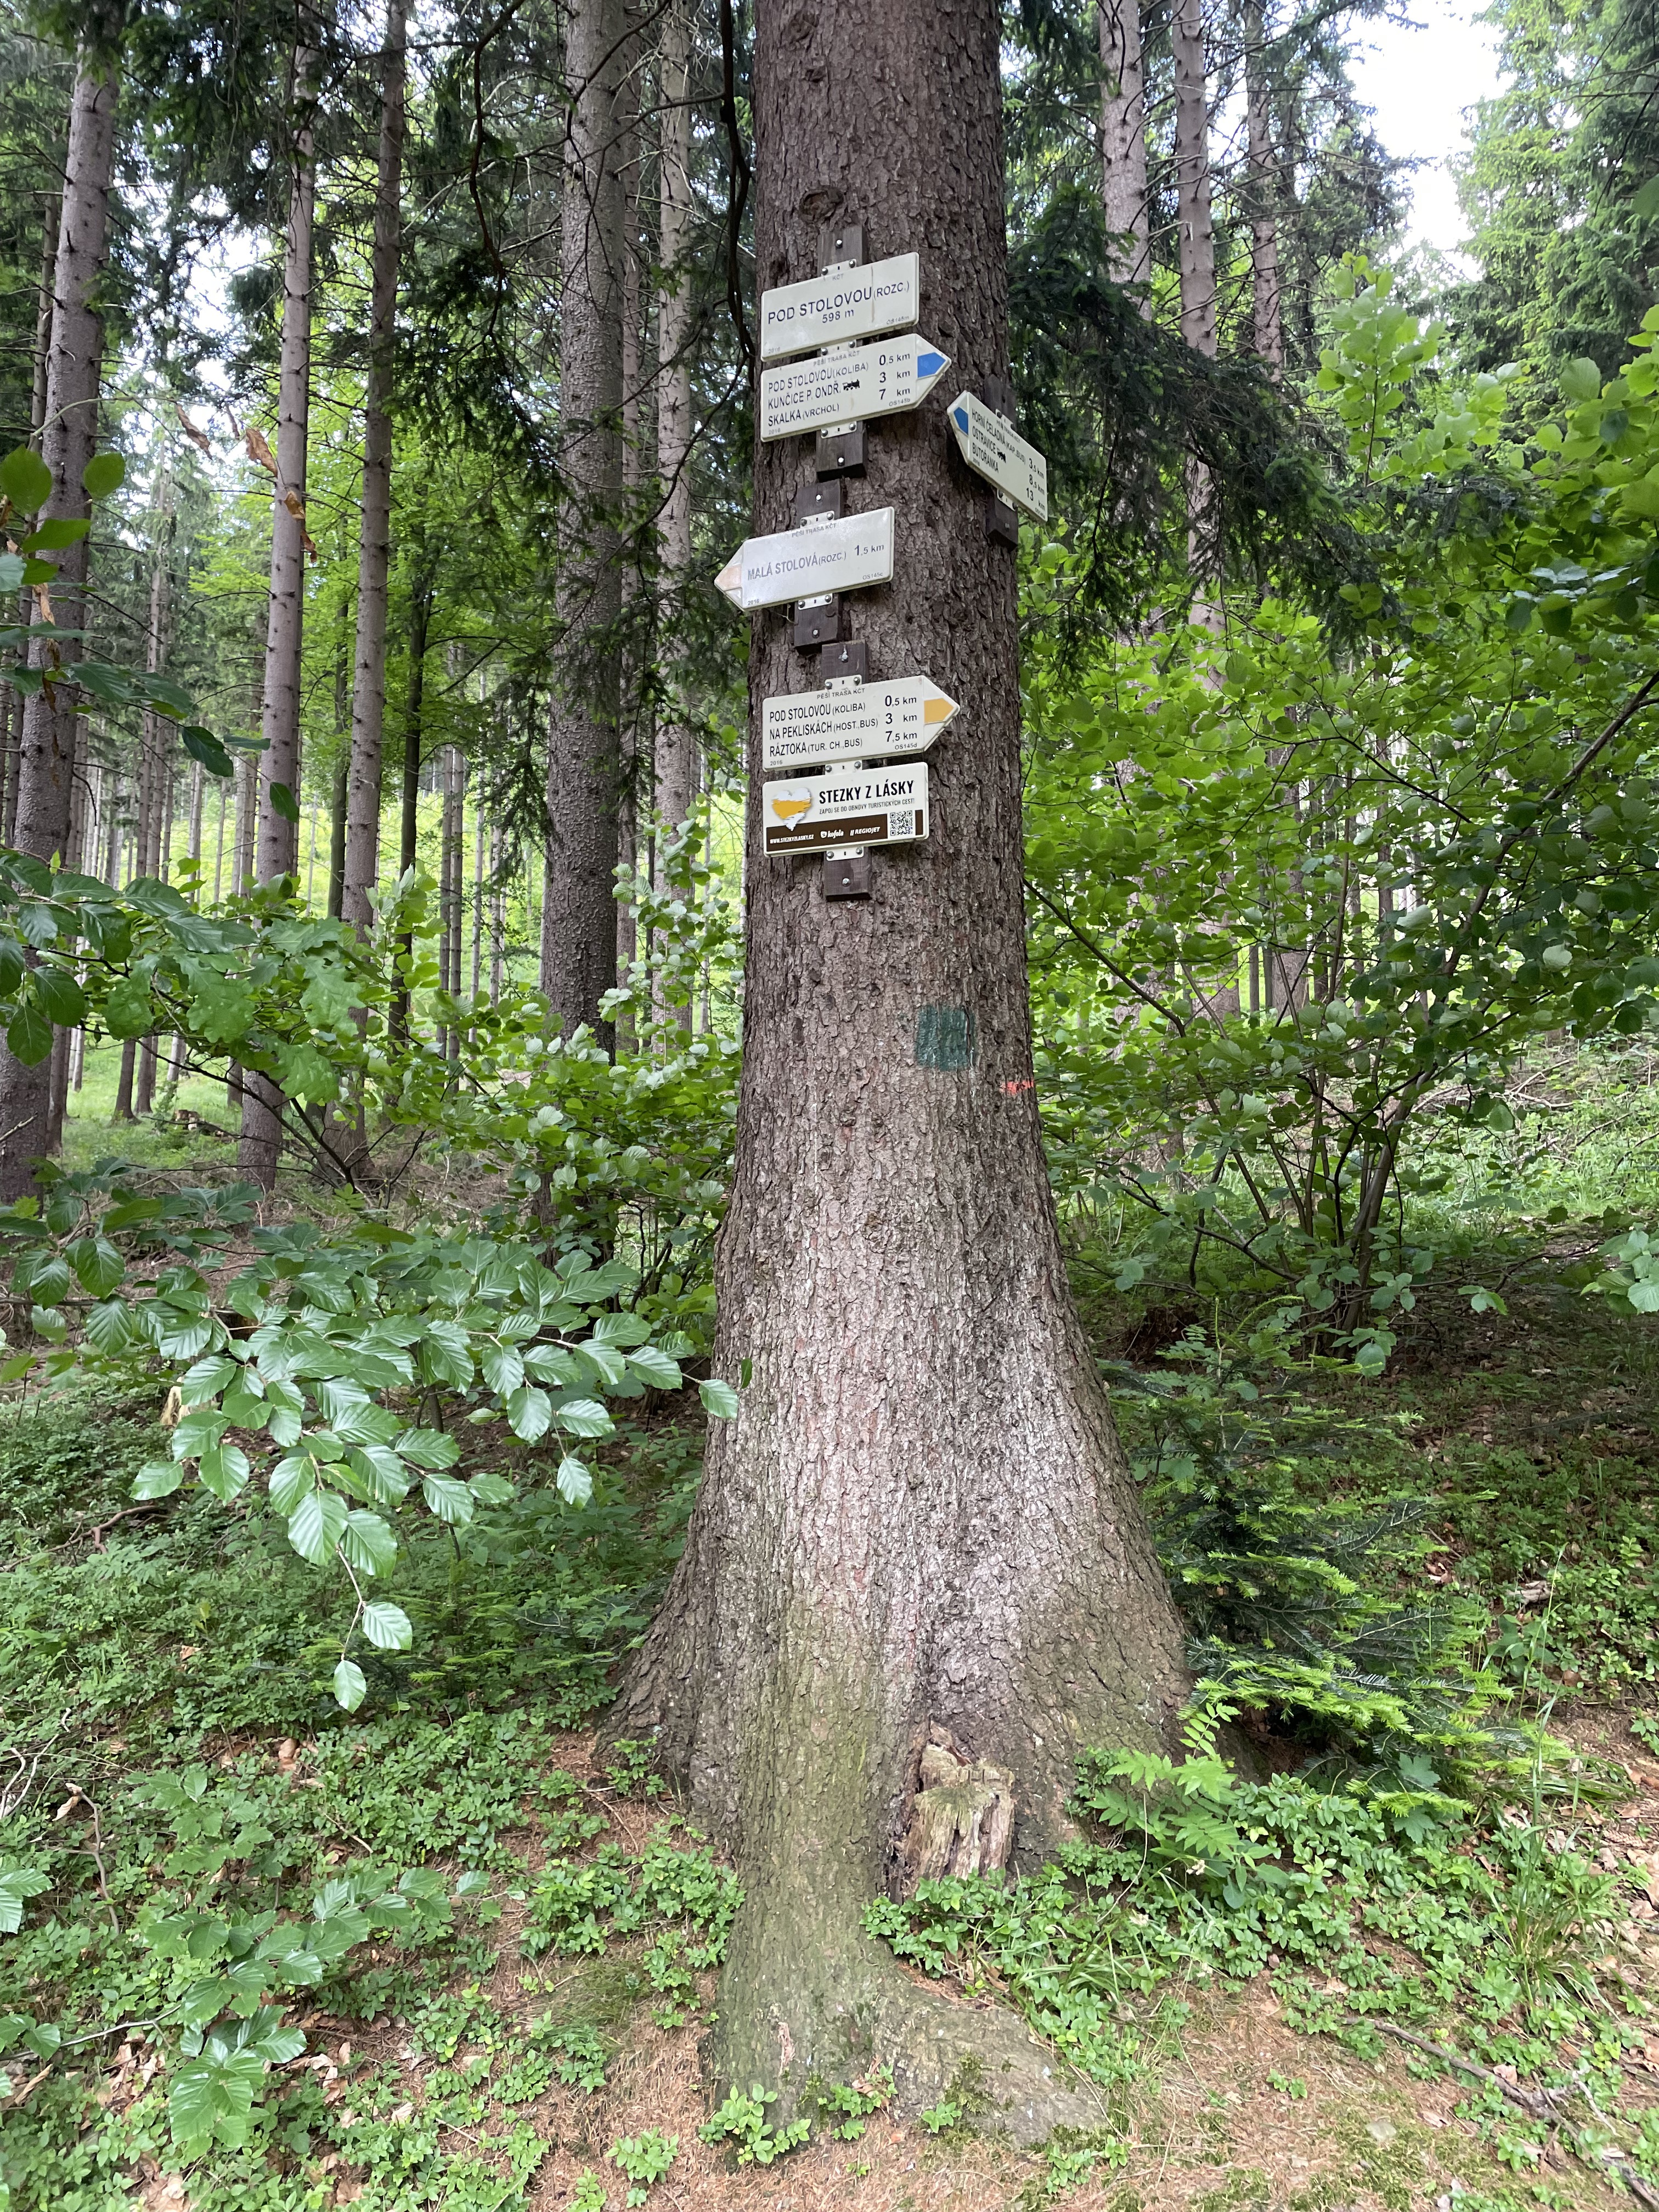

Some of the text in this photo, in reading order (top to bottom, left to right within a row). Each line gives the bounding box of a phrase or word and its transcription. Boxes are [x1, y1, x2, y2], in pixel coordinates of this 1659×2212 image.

[768, 281, 909, 324] POD STOLOVOU (ROZC.)
[822, 309, 854, 323] 598 m
[827, 354, 847, 363] TRASA
[768, 382, 785, 394] POD
[788, 368, 832, 389] STOLOVOU
[833, 362, 868, 378] (KOLIBA)
[896, 353, 910, 362] km
[768, 370, 910, 410] KUNČICE P. ONDŘ. 3 km
[768, 387, 910, 427] SKALKA (VRCHOL) 7 km
[972, 408, 985, 428] HORNÍ
[1037, 467, 1044, 479] km
[972, 426, 996, 454] OSTRAVICE
[1038, 484, 1045, 495] km
[1026, 488, 1033, 501] 13
[1039, 500, 1045, 511] km
[806, 526, 824, 535] TRASA
[748, 562, 773, 580] MALÁ
[775, 551, 818, 574] STOLOVÁ
[819, 551, 847, 567] (ROZC.)
[871, 544, 884, 554] km
[770, 695, 917, 723] POD STOLOVOU (KOLIBA) 0,5 km
[770, 728, 780, 740] NA
[782, 720, 832, 738] PEKLISKÁCH
[885, 713, 893, 724] 3
[903, 714, 917, 723] km
[770, 742, 806, 757] RÁZTOKA
[808, 743, 827, 754] (TUR.
[885, 731, 900, 743] 7,5
[903, 731, 917, 741] km
[819, 778, 914, 804] STEZKY Z LÁSKY
[868, 799, 901, 809] TURISTICKÝCH
[827, 830, 844, 839] kofola
